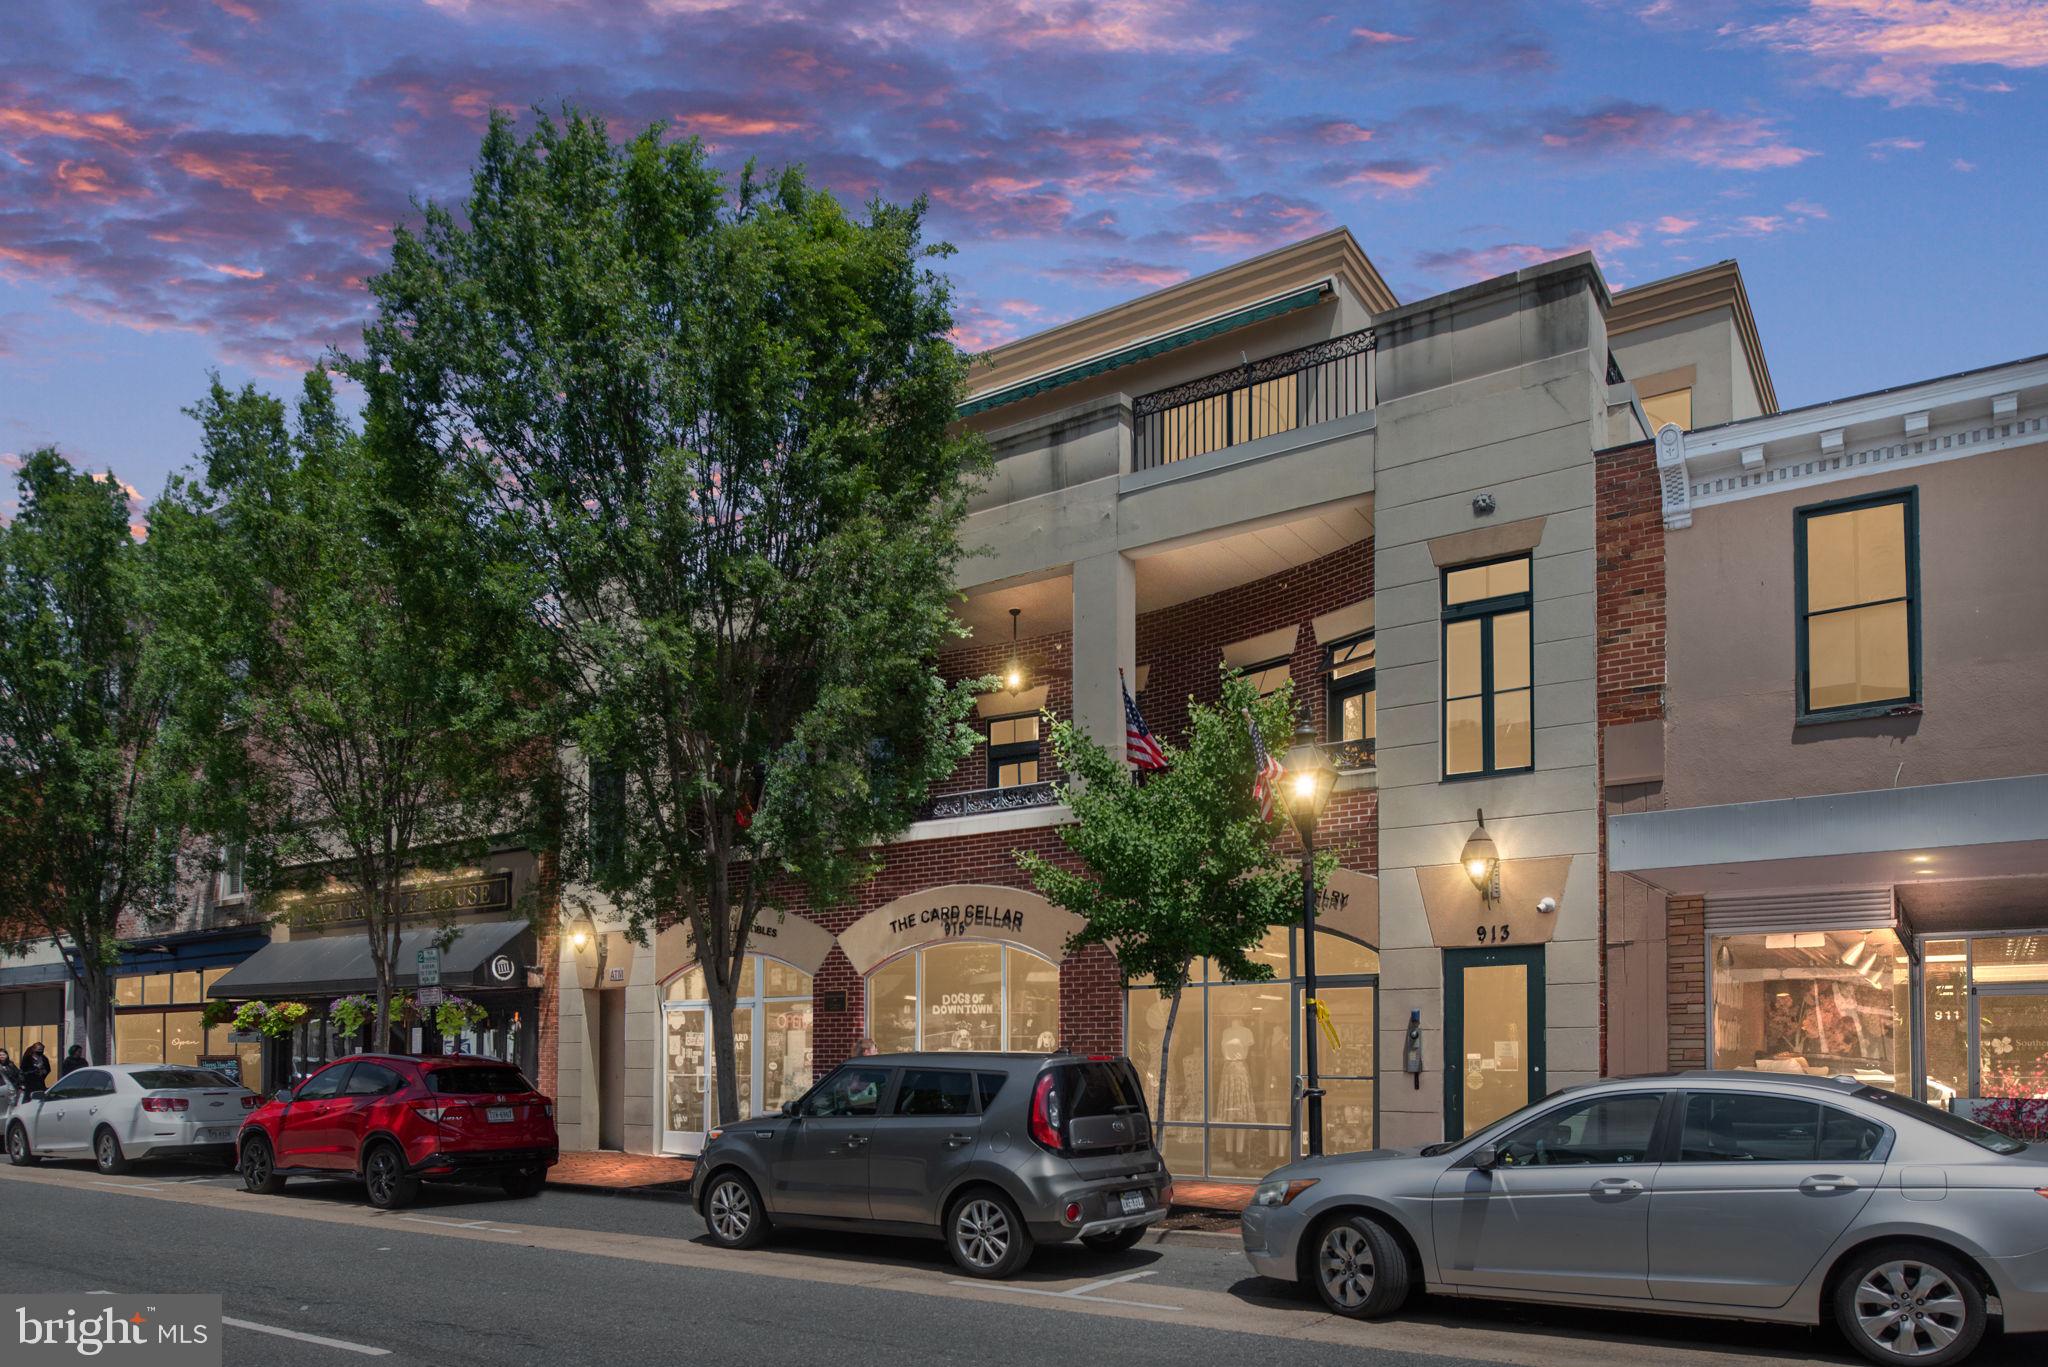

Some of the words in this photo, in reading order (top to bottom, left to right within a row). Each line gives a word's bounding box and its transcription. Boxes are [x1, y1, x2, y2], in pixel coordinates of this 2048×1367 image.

[889, 913, 917, 933] THE
[920, 905, 960, 923] CARD
[965, 905, 1024, 927] CELLAR
[1477, 924, 1510, 943] 913
[611, 969, 624, 979] ATM
[942, 993, 970, 1004] DOGS
[972, 993, 985, 1003] OF
[932, 1004, 993, 1014] DOWNTOWN
[1934, 1010, 1960, 1021] 911
[172, 1038, 200, 1049] Open
[2015, 1039, 2048, 1047] Southe
